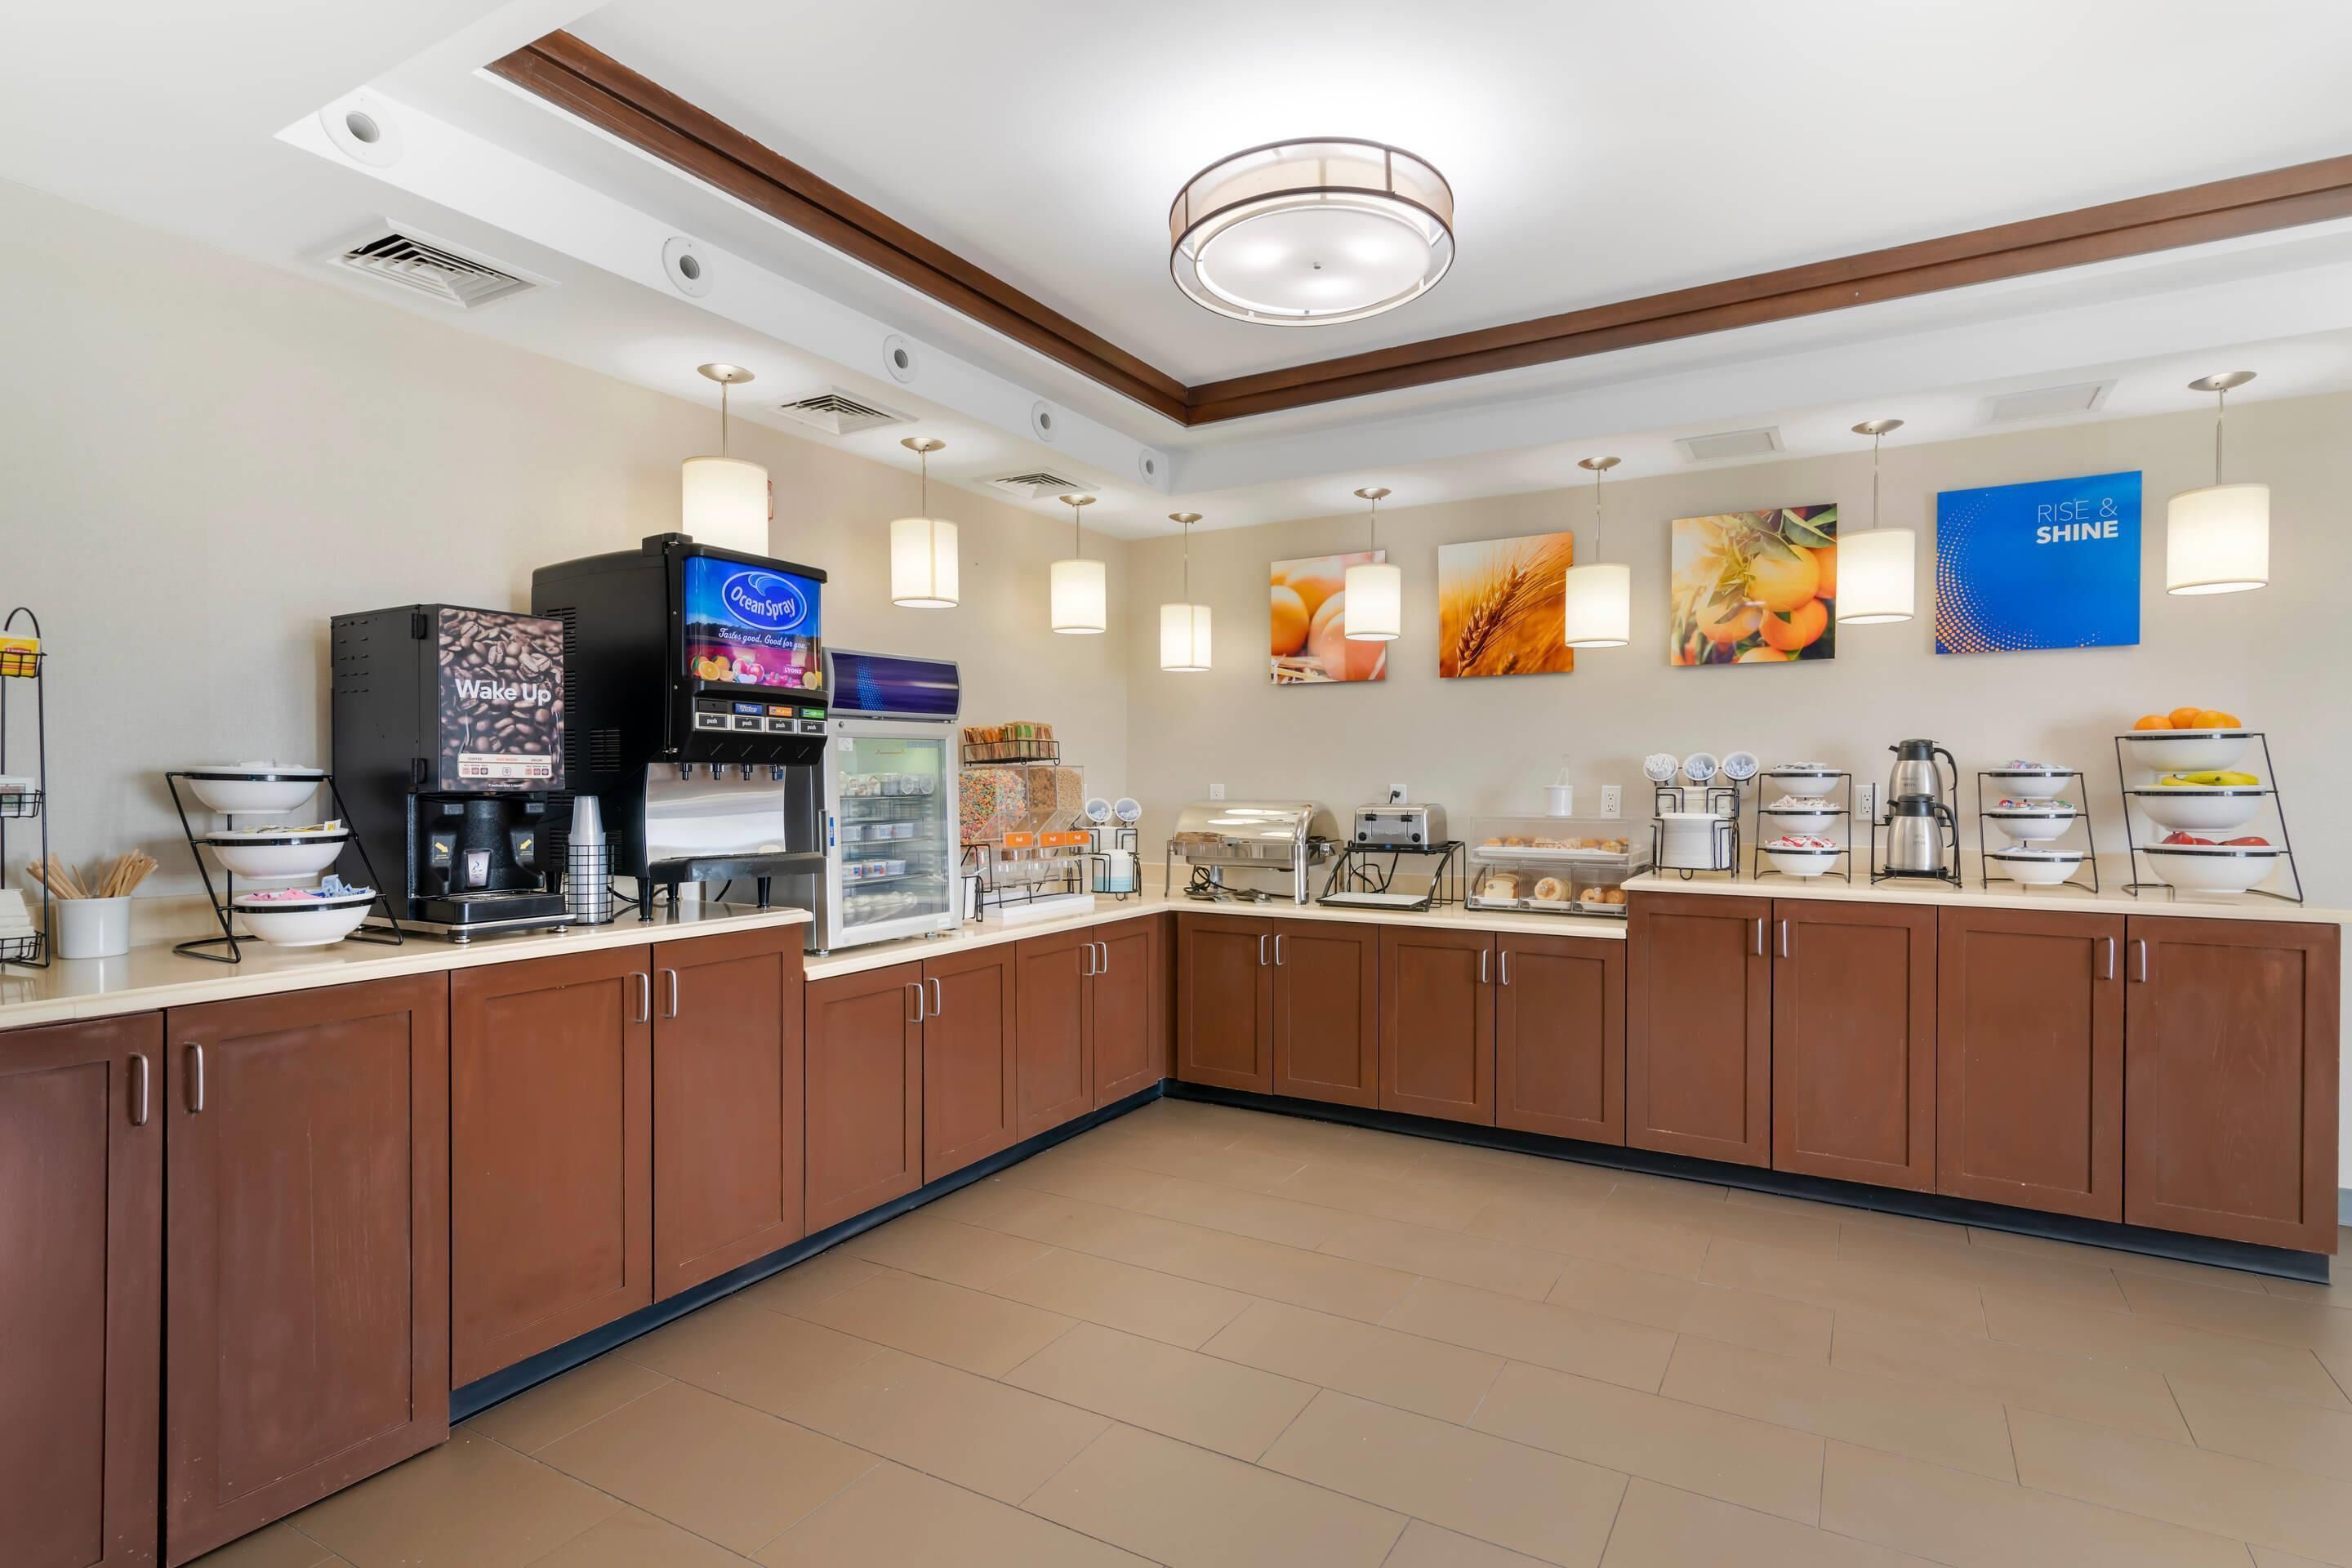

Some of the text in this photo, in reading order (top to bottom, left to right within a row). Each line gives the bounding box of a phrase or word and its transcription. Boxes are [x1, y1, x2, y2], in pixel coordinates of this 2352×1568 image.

[2038, 497, 2118, 523] RISE &
[2036, 520, 2118, 544] SHINE
[731, 586, 795, 621] Ocean Spray
[719, 628, 742, 640] Tastes
[742, 634, 762, 644] good.
[764, 635, 782, 645] Good
[782, 637, 793, 648] for
[455, 679, 551, 706] Wake Up
[739, 705, 758, 713] Water
